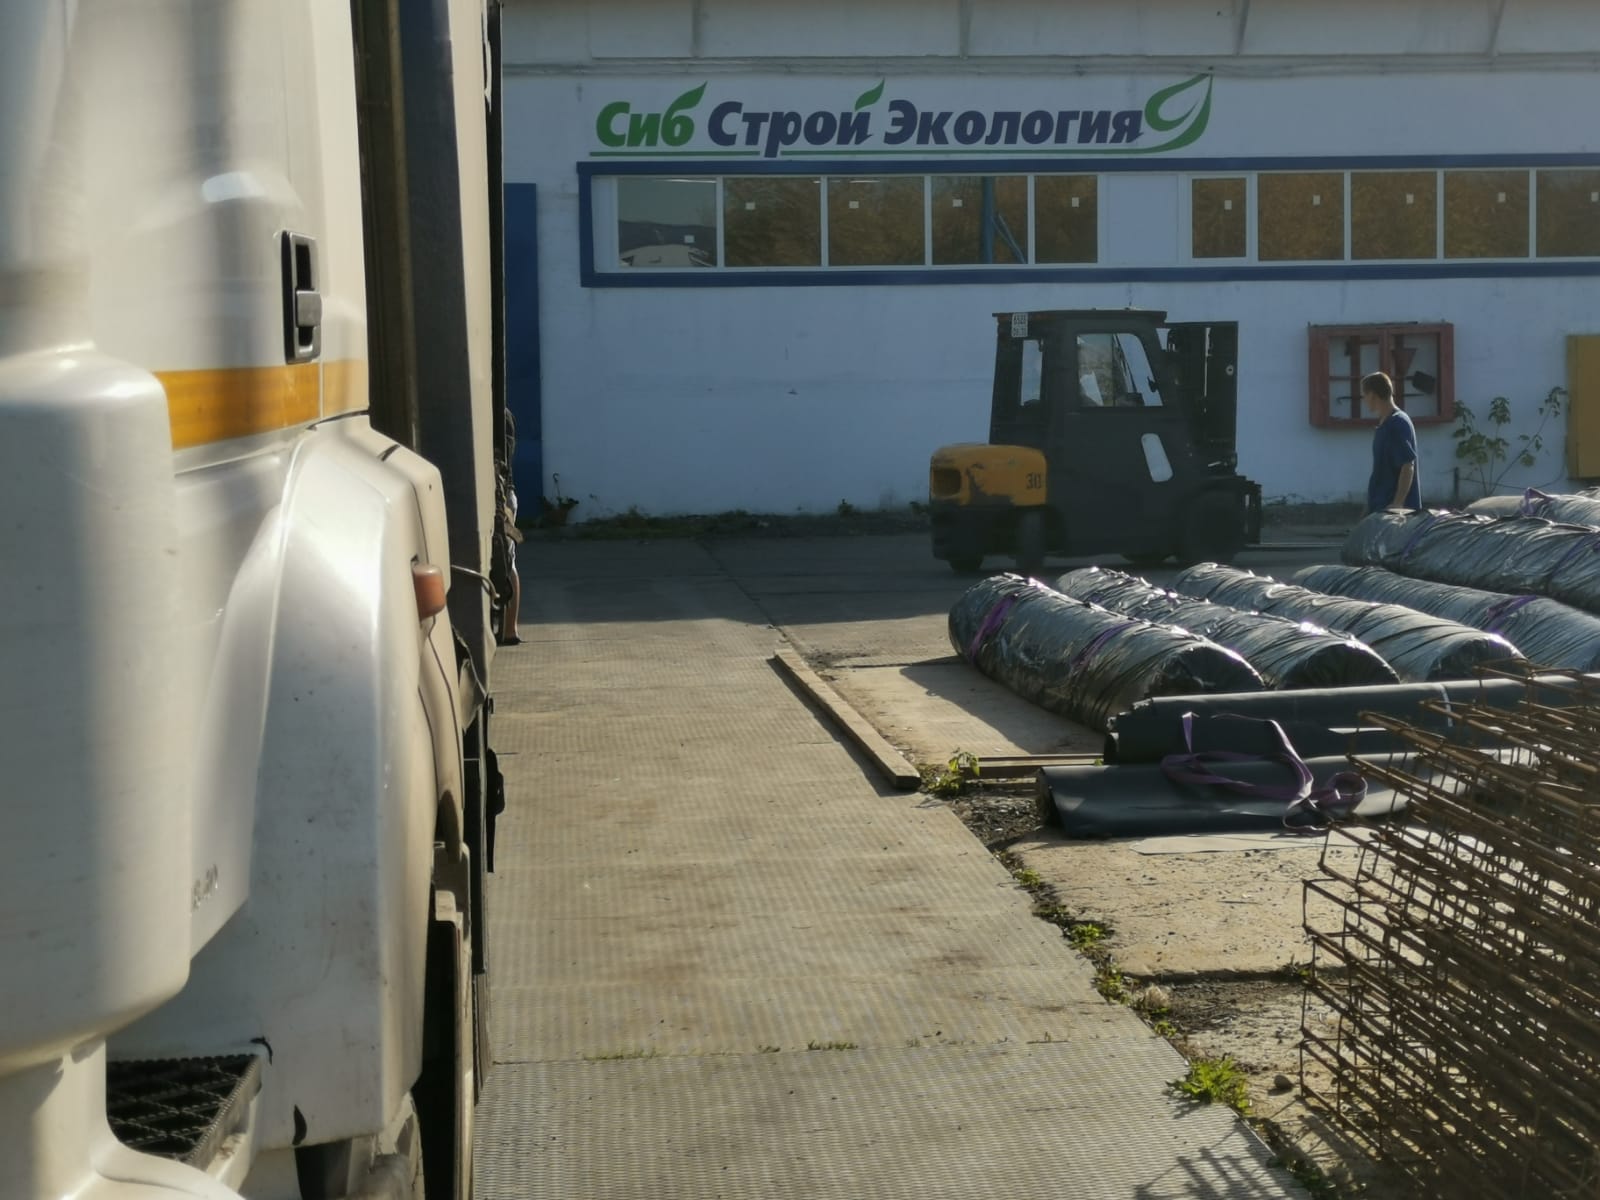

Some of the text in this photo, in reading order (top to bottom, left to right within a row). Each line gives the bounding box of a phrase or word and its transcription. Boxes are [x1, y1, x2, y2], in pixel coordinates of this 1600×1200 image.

[596, 78, 1144, 158] Сиб Строй Экология
